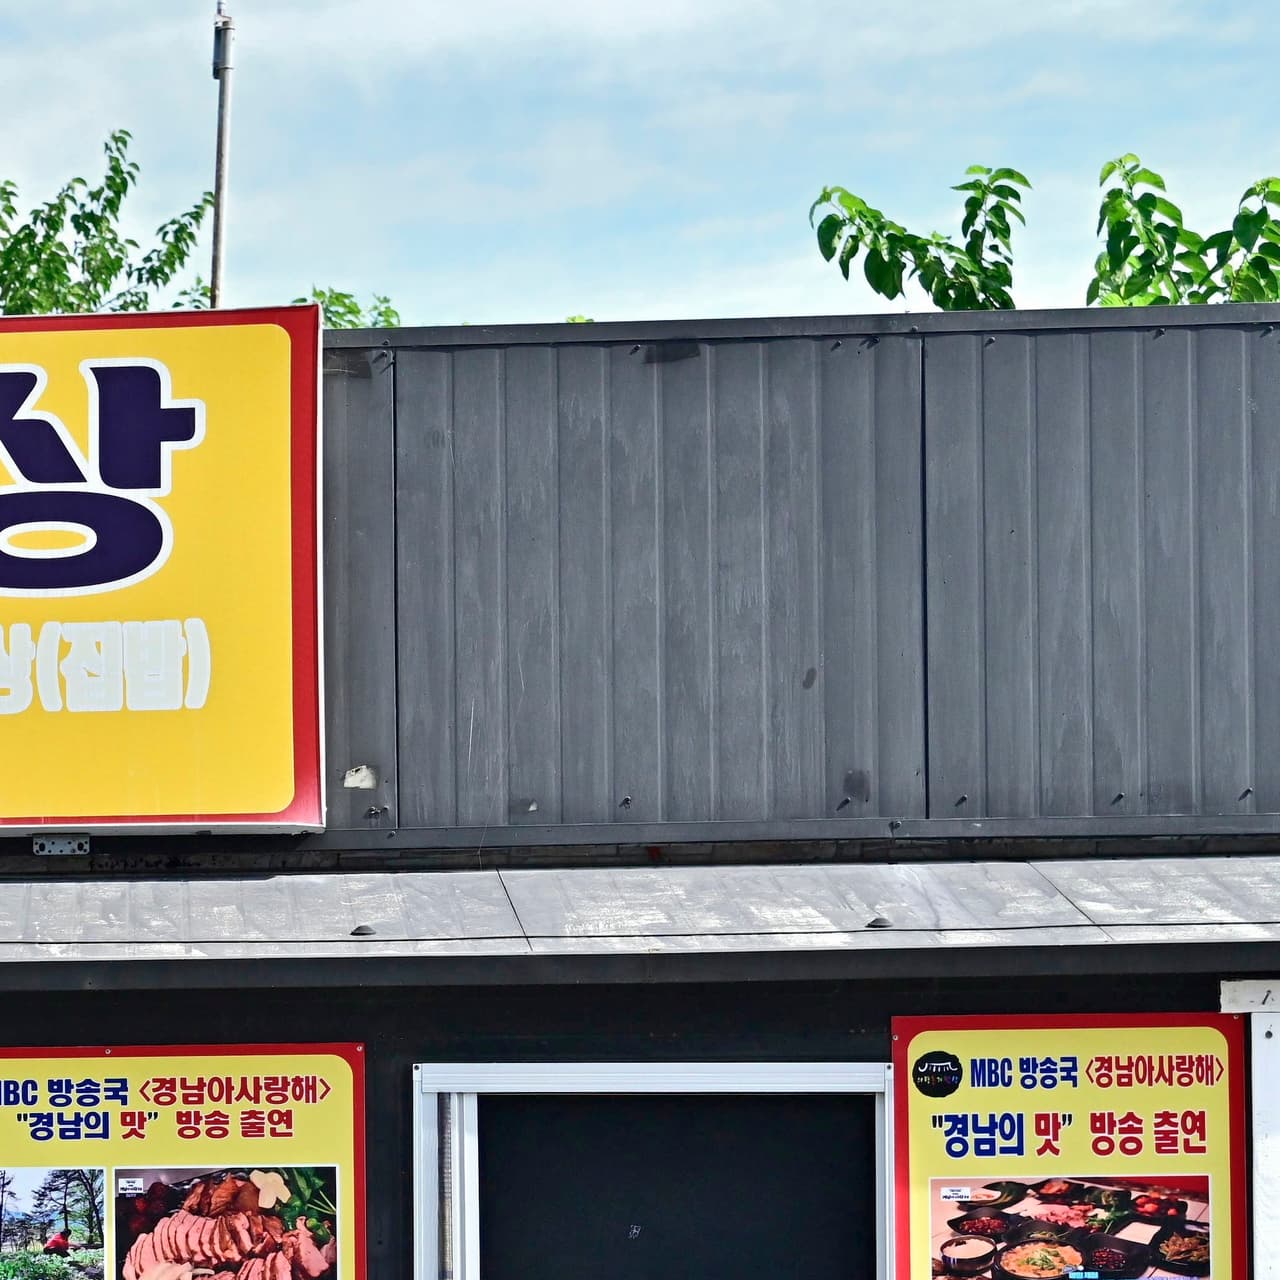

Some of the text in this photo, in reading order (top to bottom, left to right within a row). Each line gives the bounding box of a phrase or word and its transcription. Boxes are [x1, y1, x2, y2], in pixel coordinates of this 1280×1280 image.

[970, 1059, 1012, 1087] MBC
[1019, 1057, 1078, 1088] 방송국
[47, 1078, 128, 1106] 방송국
[176, 1110, 229, 1139] 방송
[239, 1109, 294, 1138] 출연
[1090, 1112, 1144, 1155] 방송
[1154, 1110, 1207, 1154] 출연
